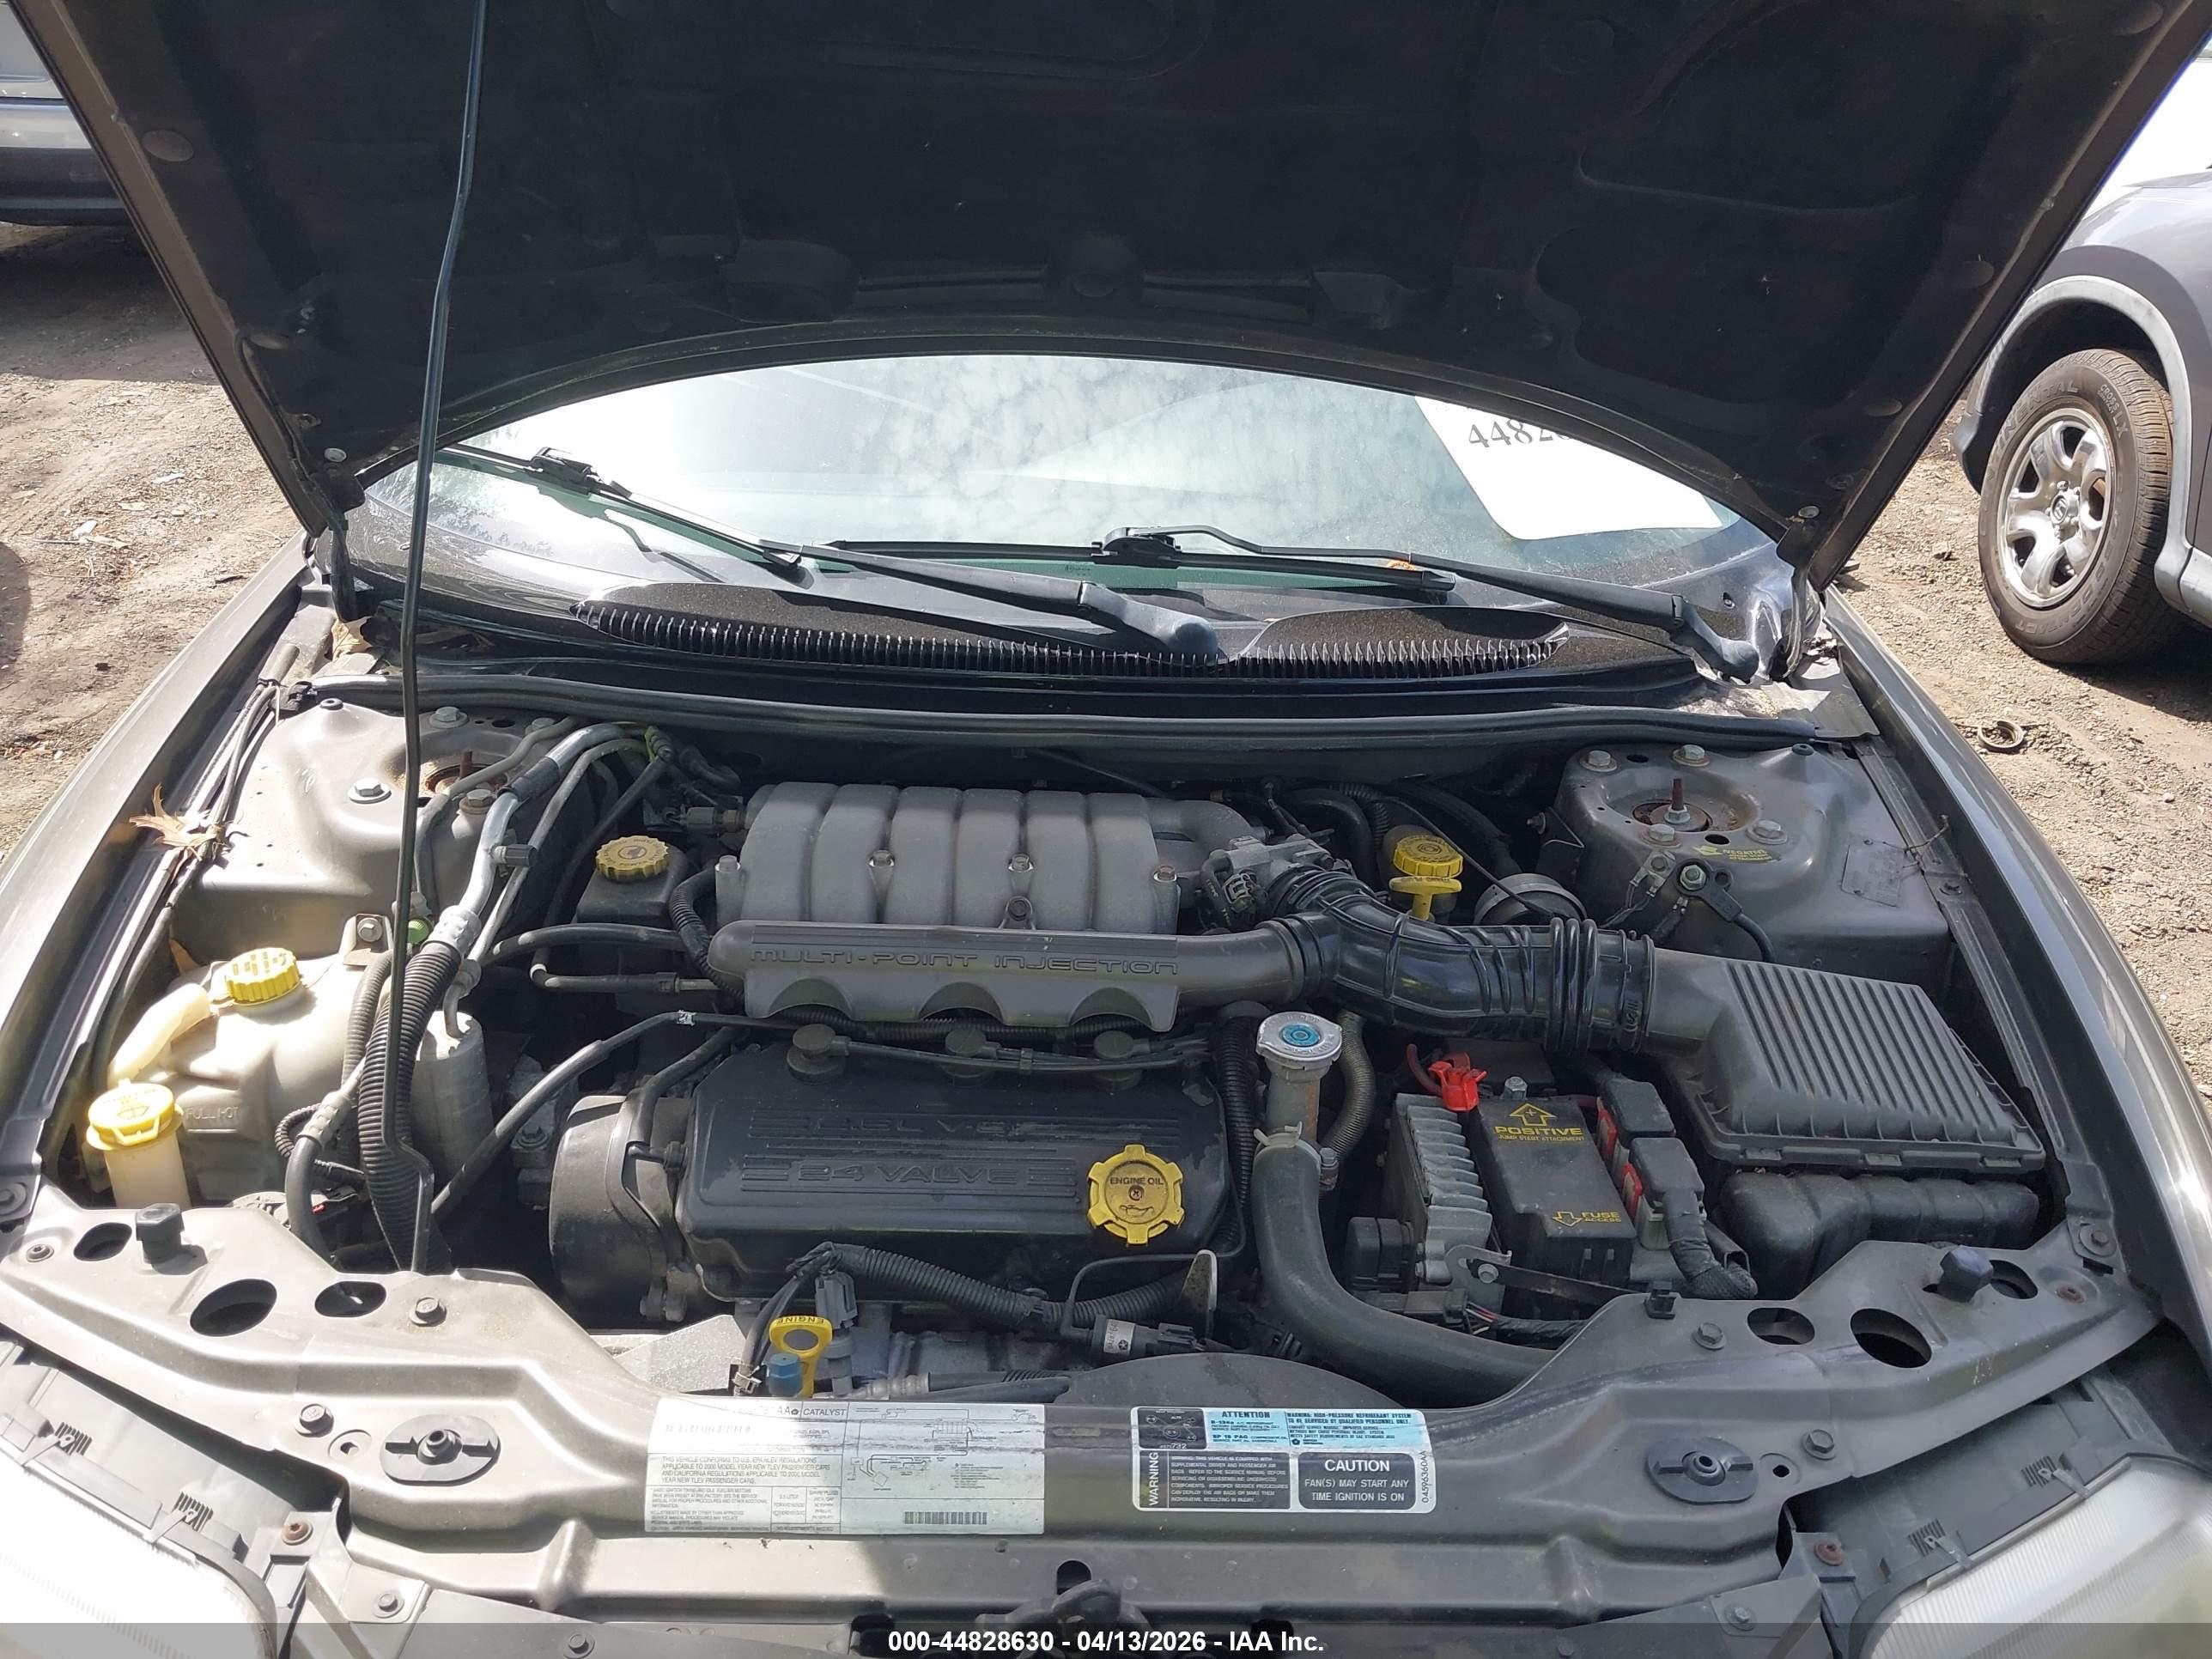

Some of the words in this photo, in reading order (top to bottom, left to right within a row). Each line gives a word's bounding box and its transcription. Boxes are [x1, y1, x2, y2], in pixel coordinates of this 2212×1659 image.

[2112, 410, 2130, 440] LX
[750, 949, 977, 968] MULTI-POINT
[994, 955, 1178, 975] INJECTION
[1495, 1126, 1583, 1135] POSITIVE
[799, 1165, 865, 1182] 24
[878, 1166, 1018, 1184] VALVE
[1109, 1176, 1146, 1185] ENGINE
[1324, 1459, 1390, 1472] CAUTION
[1149, 1452, 1159, 1506] WARNING
[1304, 1479, 1335, 1488] FAN(S)
[1340, 1479, 1358, 1488] MAY
[1360, 1479, 1388, 1488] START
[1391, 1480, 1409, 1488] ANY
[1312, 1492, 1331, 1501] TIME
[1335, 1492, 1375, 1501] IGNITION
[1378, 1492, 1387, 1501] IS
